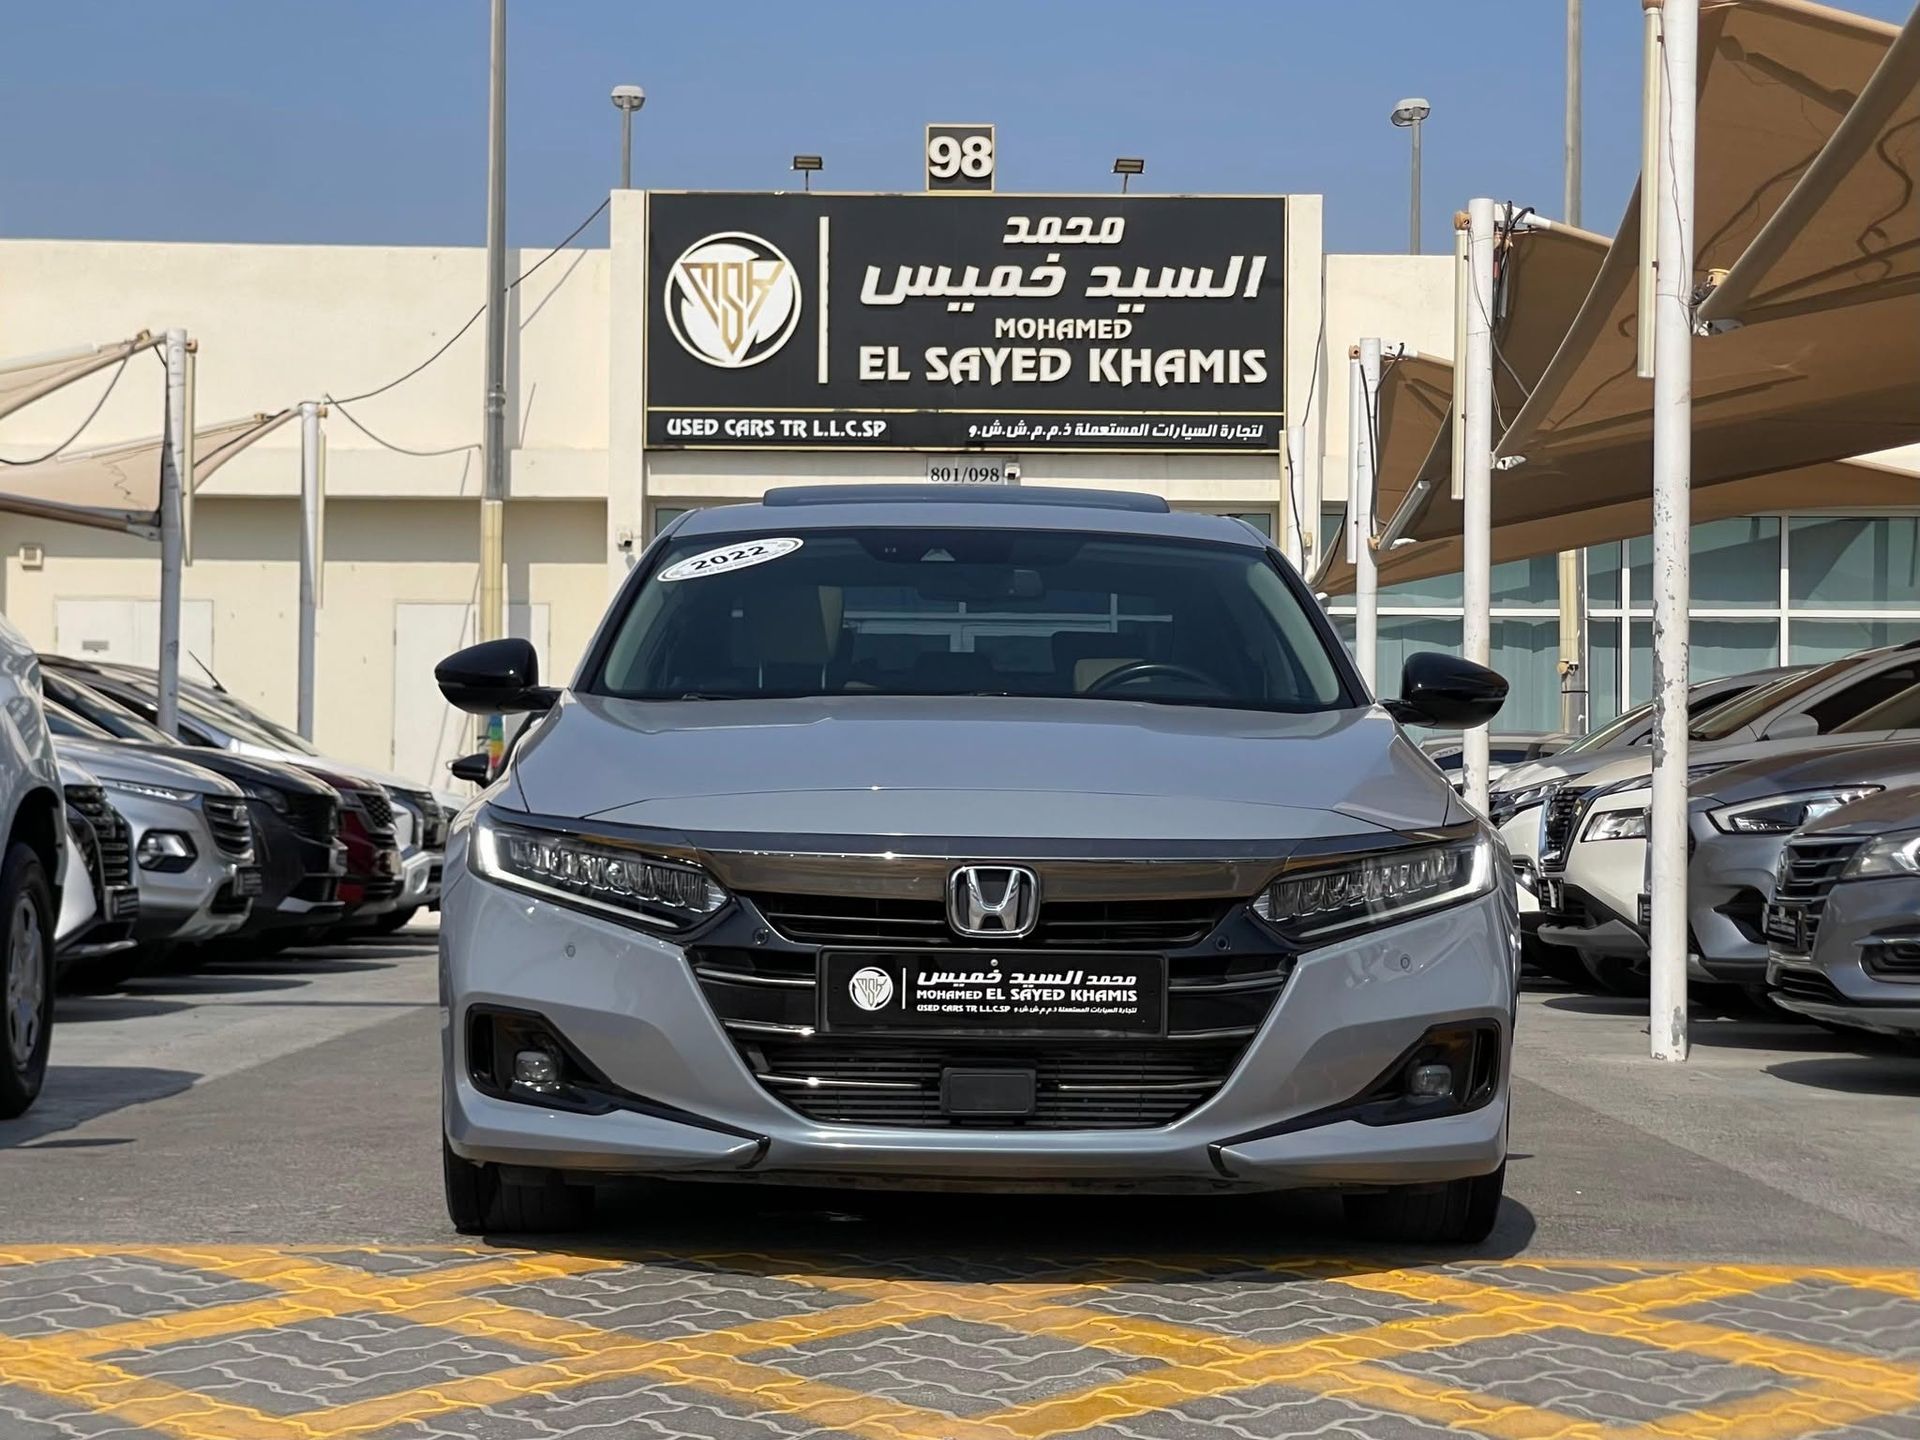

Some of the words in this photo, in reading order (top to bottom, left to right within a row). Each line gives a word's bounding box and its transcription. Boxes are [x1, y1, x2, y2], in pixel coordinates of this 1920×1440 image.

[928, 135, 994, 179] 98
[1002, 216, 1127, 245] محمد
[859, 252, 1068, 313] خميس
[1084, 254, 1269, 314] السيد
[994, 316, 1133, 341] MOHAMED
[858, 344, 912, 382] EL
[924, 345, 1073, 387] SAYED
[1088, 346, 1269, 388] KHAMIS
[666, 418, 719, 437] USED
[724, 418, 776, 439] CARS
[779, 419, 808, 438] TR
[813, 419, 888, 438] L.L.C.SP
[1074, 422, 1150, 438] المستعملة
[1151, 422, 1218, 440] السيارات
[1219, 423, 1264, 441] لتجارة
[930, 466, 1000, 483] 801/098
[690, 546, 769, 571] 2022
[917, 968, 1003, 988] خميس
[1008, 970, 1085, 988] السيد
[1085, 974, 1138, 986] محمد
[916, 989, 983, 1001] MOHAMED
[986, 987, 1006, 1001] EL
[1010, 988, 1066, 1002] SAYED
[1070, 988, 1138, 1002] KHAMIS
[916, 1004, 940, 1012] USED
[941, 1004, 964, 1013] CARS
[965, 1004, 978, 1013] TR
